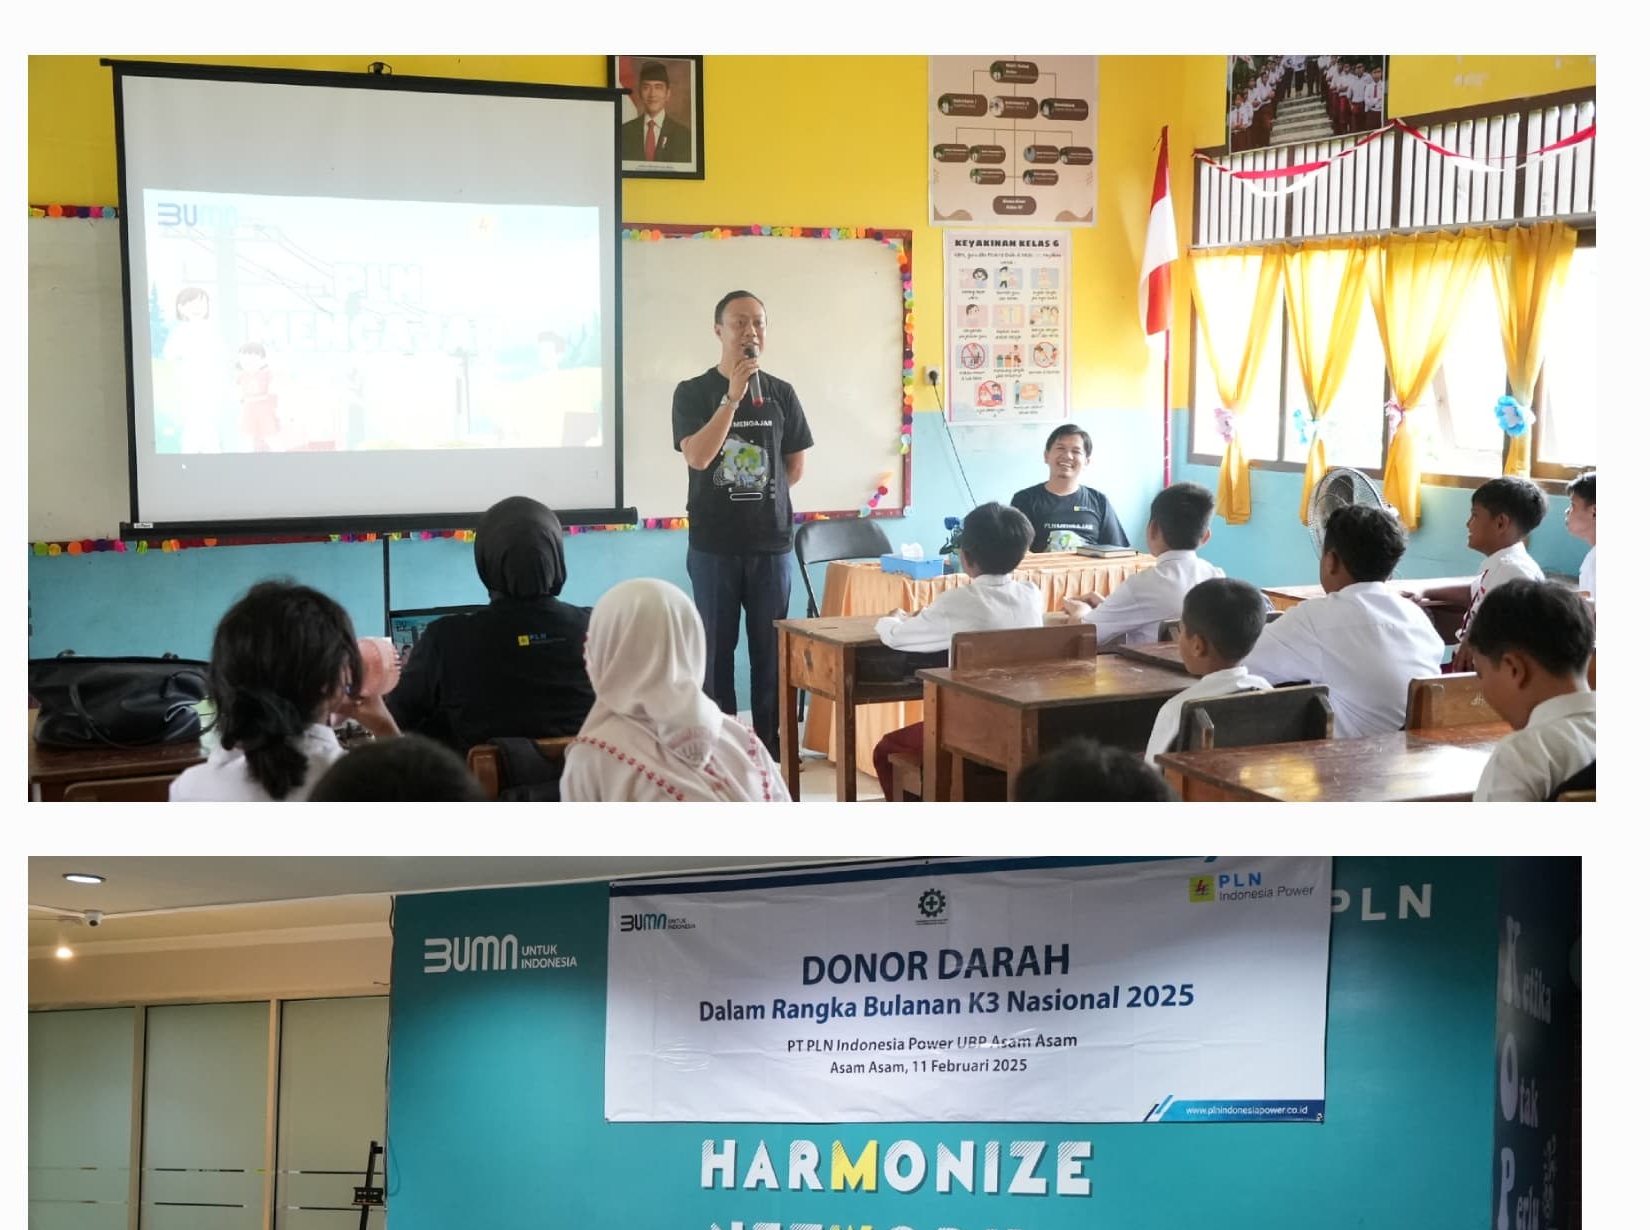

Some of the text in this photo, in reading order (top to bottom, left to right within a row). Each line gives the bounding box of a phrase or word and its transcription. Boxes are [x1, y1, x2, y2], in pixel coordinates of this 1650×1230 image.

[955, 240, 1016, 248] KEYAKINAN
[1019, 240, 1050, 248] KELAS
[1219, 872, 1262, 888] PLN
[1219, 883, 1314, 902] Indonesia Power
[1332, 883, 1432, 921] PLN
[521, 945, 558, 956] UNTUK
[521, 957, 577, 969] INDONESIA
[803, 943, 1070, 986] DONOR DARAH
[699, 984, 1194, 1026] Dalam Rangka Bulanan K3 Nasional 2025
[787, 1034, 1078, 1053] PT PLN Indonesia Power UBP Asam Asam
[830, 1059, 1027, 1077] Asam Asam, 11 Februari 2025
[1500, 1032, 1539, 1128] Otak
[1186, 1104, 1308, 1117] www.plnindonesiapower.co.id
[700, 1139, 1093, 1196] HARMONIZE
